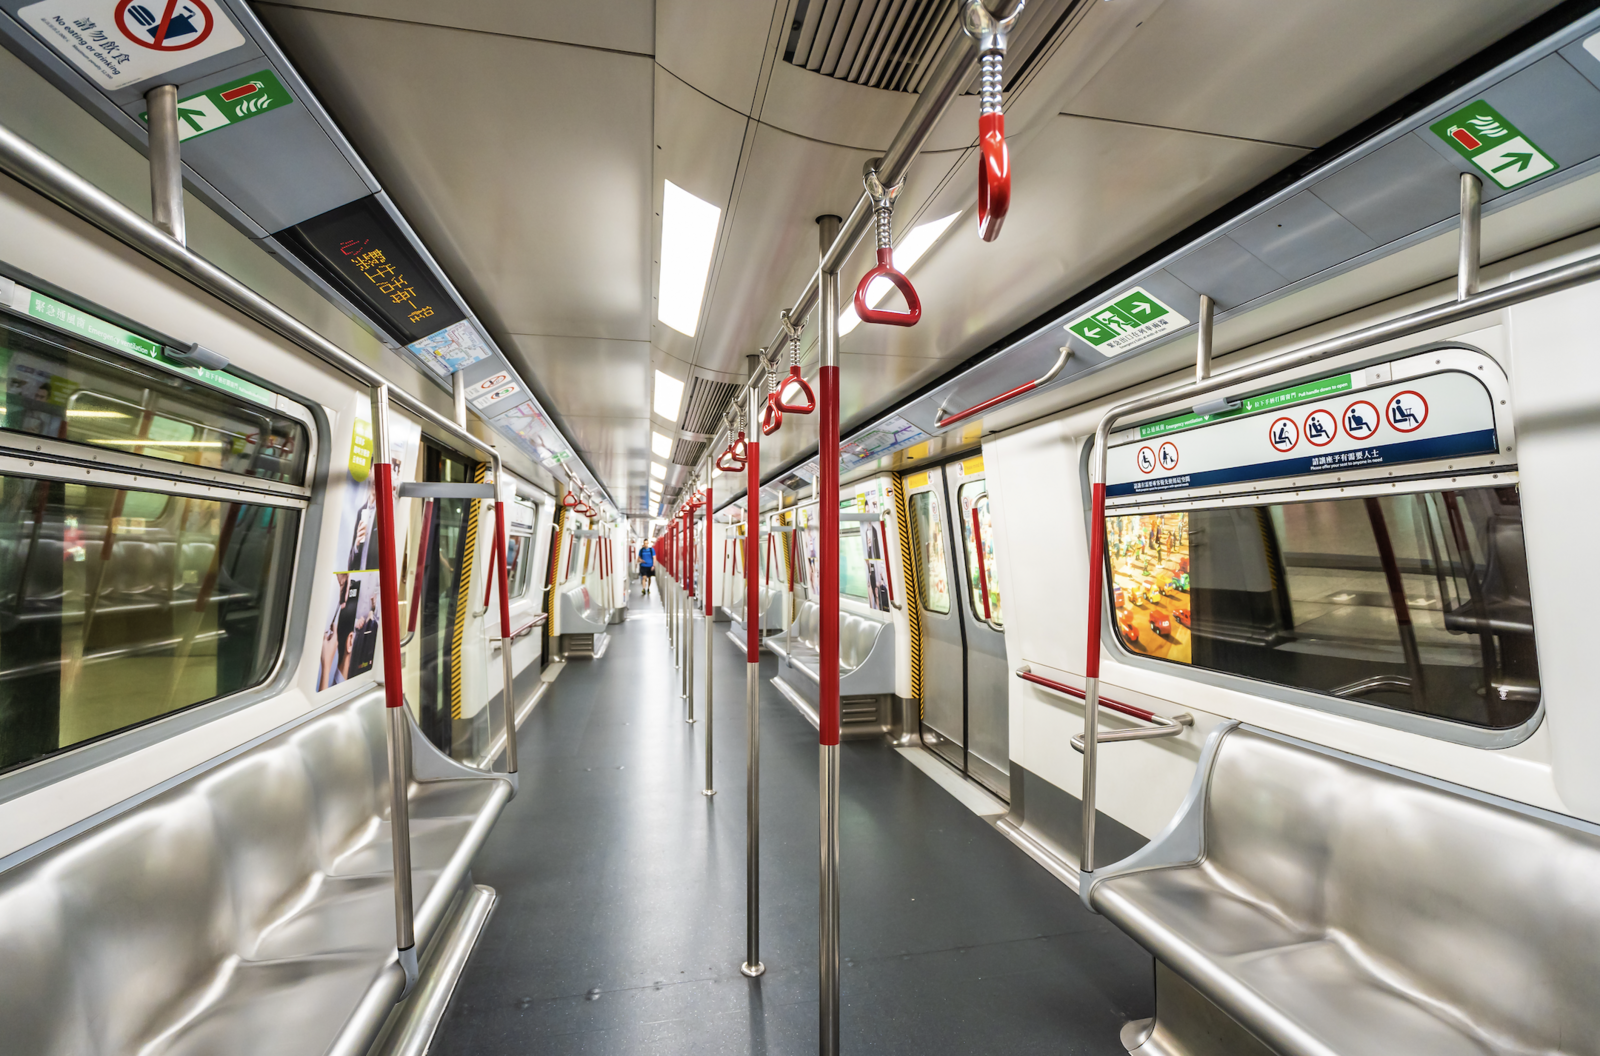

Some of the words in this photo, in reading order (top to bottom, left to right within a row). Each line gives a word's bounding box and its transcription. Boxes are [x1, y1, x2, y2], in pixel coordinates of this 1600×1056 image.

[52, 15, 66, 27] No
[64, 25, 87, 46] eating
[85, 44, 96, 52] or
[93, 51, 121, 76] drinking
[73, 16, 131, 65] 請勿飲食
[87, 324, 121, 345] Emergency
[120, 339, 148, 355] ventilation
[1305, 388, 1320, 397] handle
[1319, 386, 1331, 394] down
[1336, 382, 1348, 390] open
[1166, 421, 1184, 430] Emergency
[1184, 417, 1203, 426] ventilation
[1311, 449, 1379, 466] 請讓座予有需要人士
